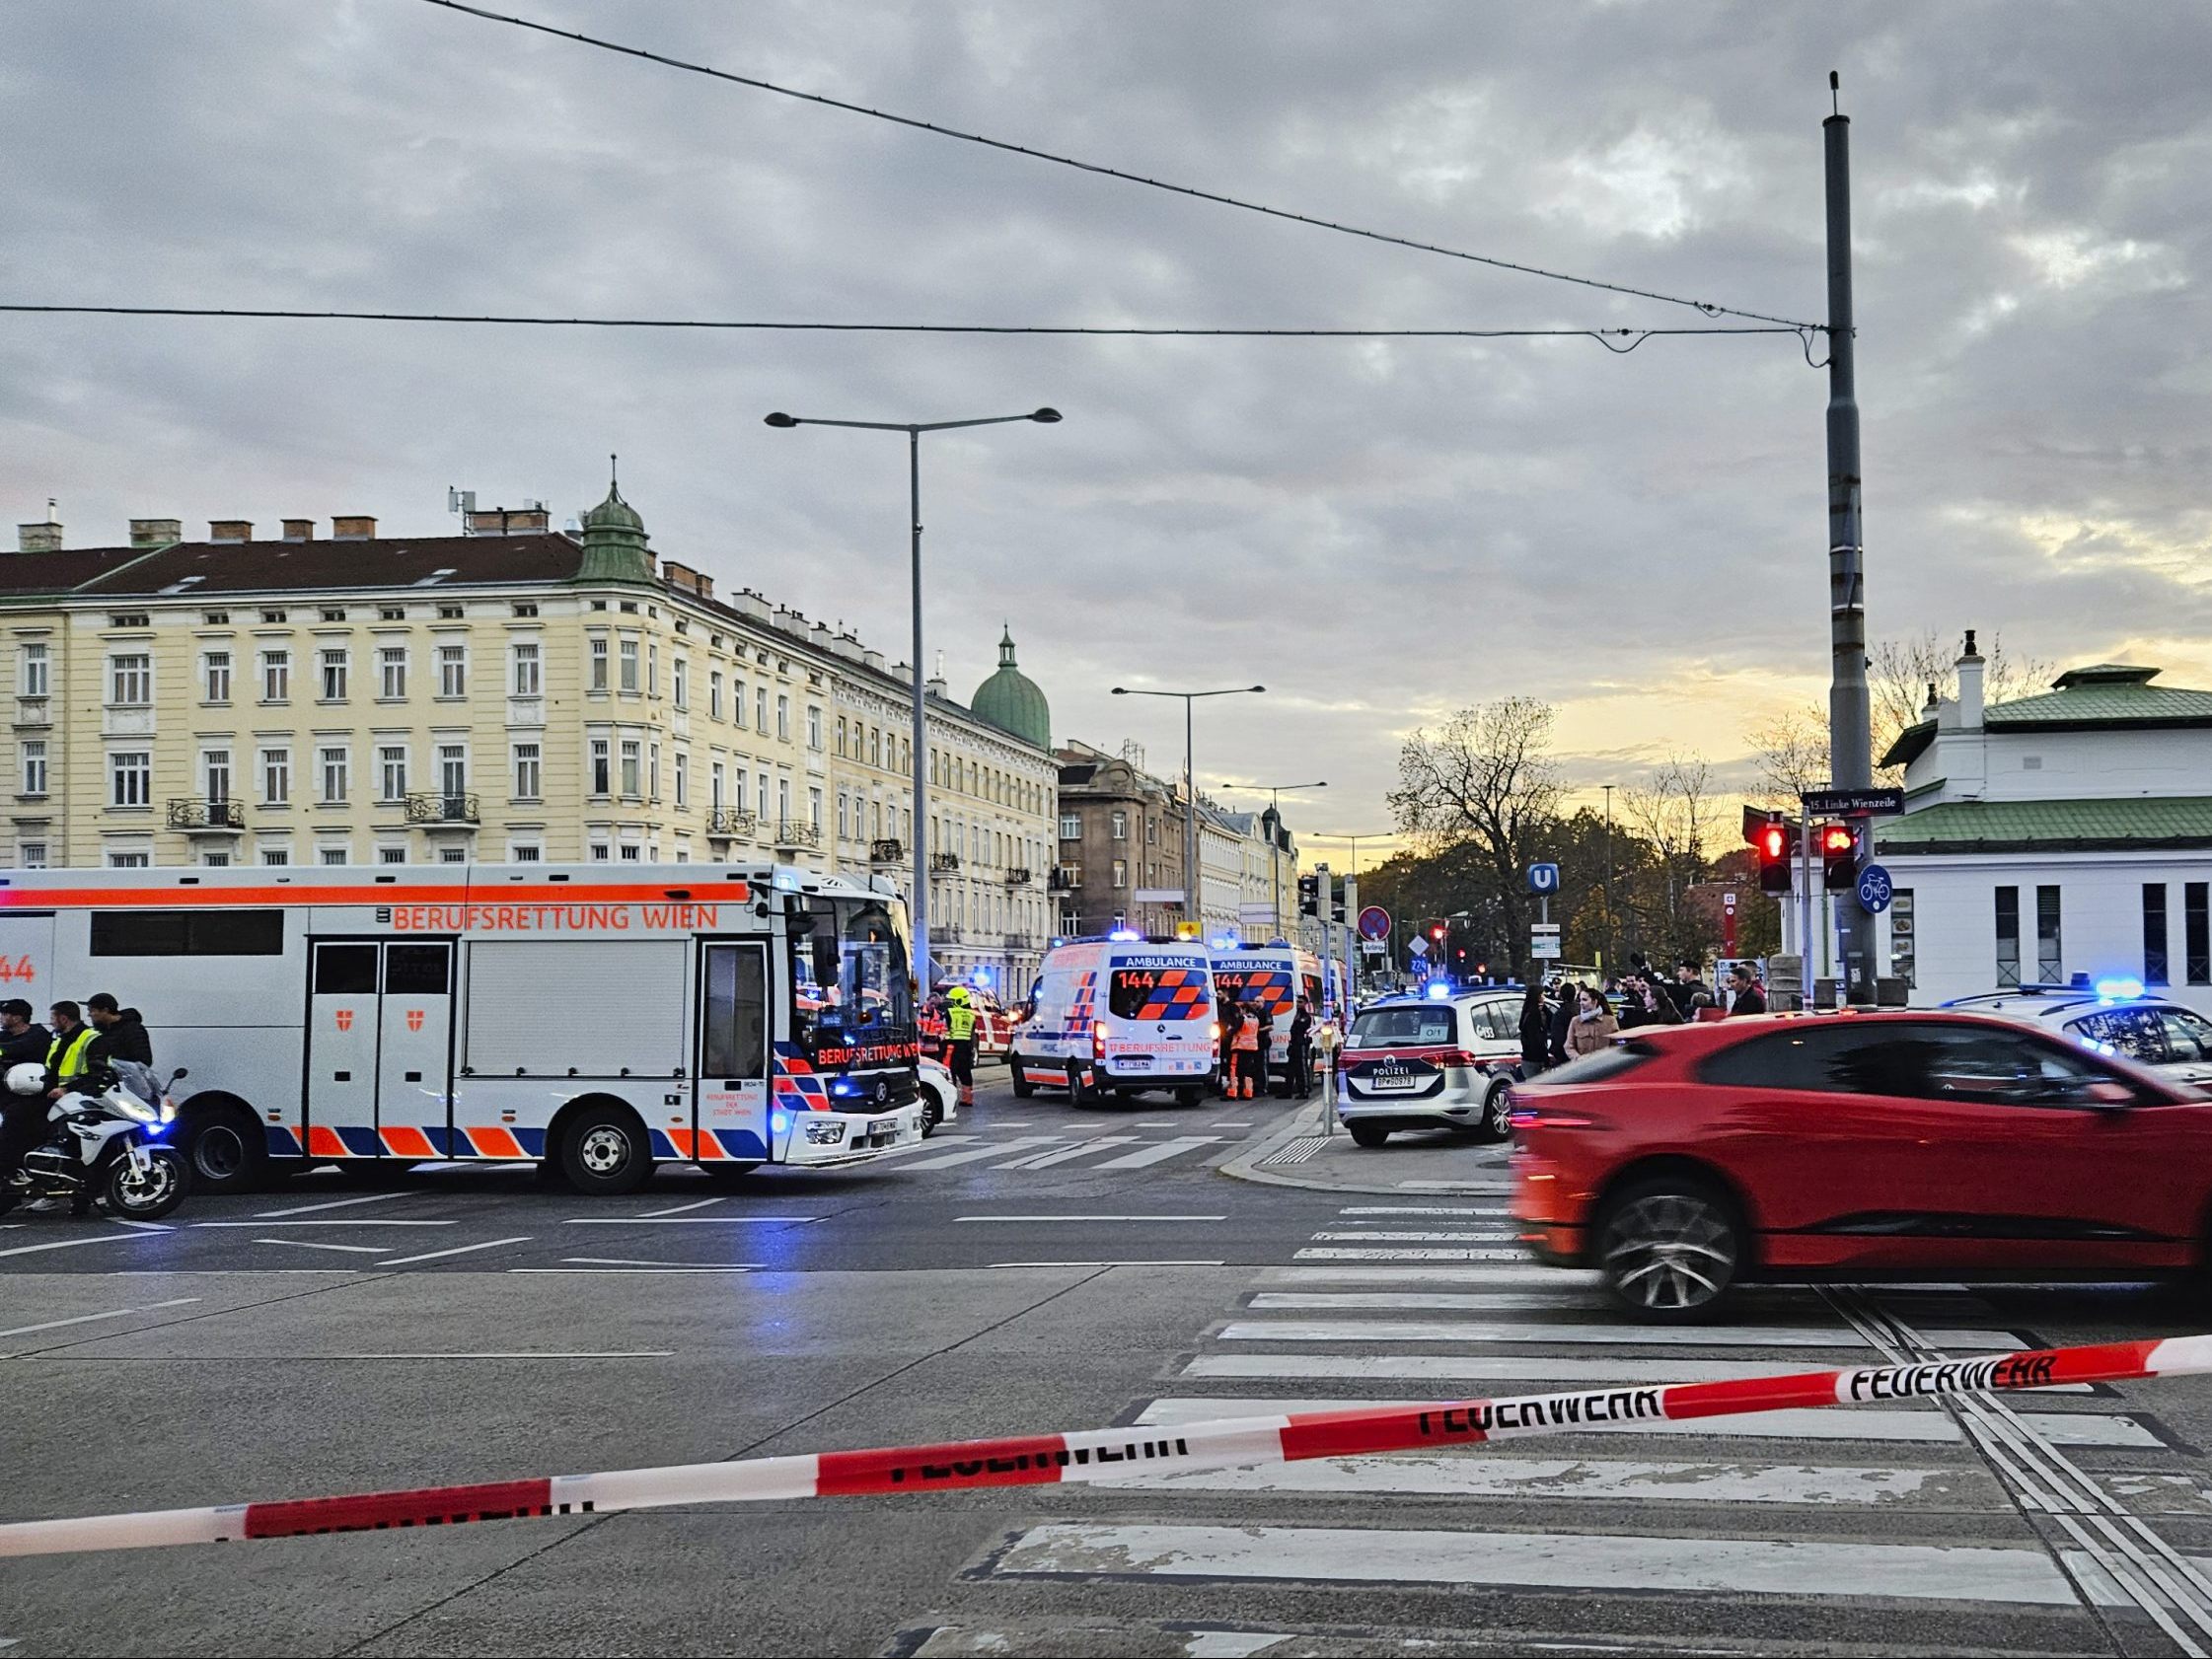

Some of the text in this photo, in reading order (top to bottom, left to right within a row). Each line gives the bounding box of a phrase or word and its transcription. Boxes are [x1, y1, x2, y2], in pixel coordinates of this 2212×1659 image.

[1825, 799, 1850, 809] Linke
[1851, 797, 1896, 808] Wienzeile
[1534, 870, 1552, 889] U
[395, 904, 717, 930] BERUFSRETTUNG WIEN
[1126, 957, 1196, 968] AMBULANCE
[1219, 961, 1282, 970] AMBULANCE
[1119, 972, 1154, 988] 144
[1214, 974, 1243, 988] 144
[1119, 1043, 1211, 1052] BERUFSRETTUNG
[1372, 1066, 1409, 1075] POLIZEI
[1851, 1355, 2057, 1401] FEUERWEHR
